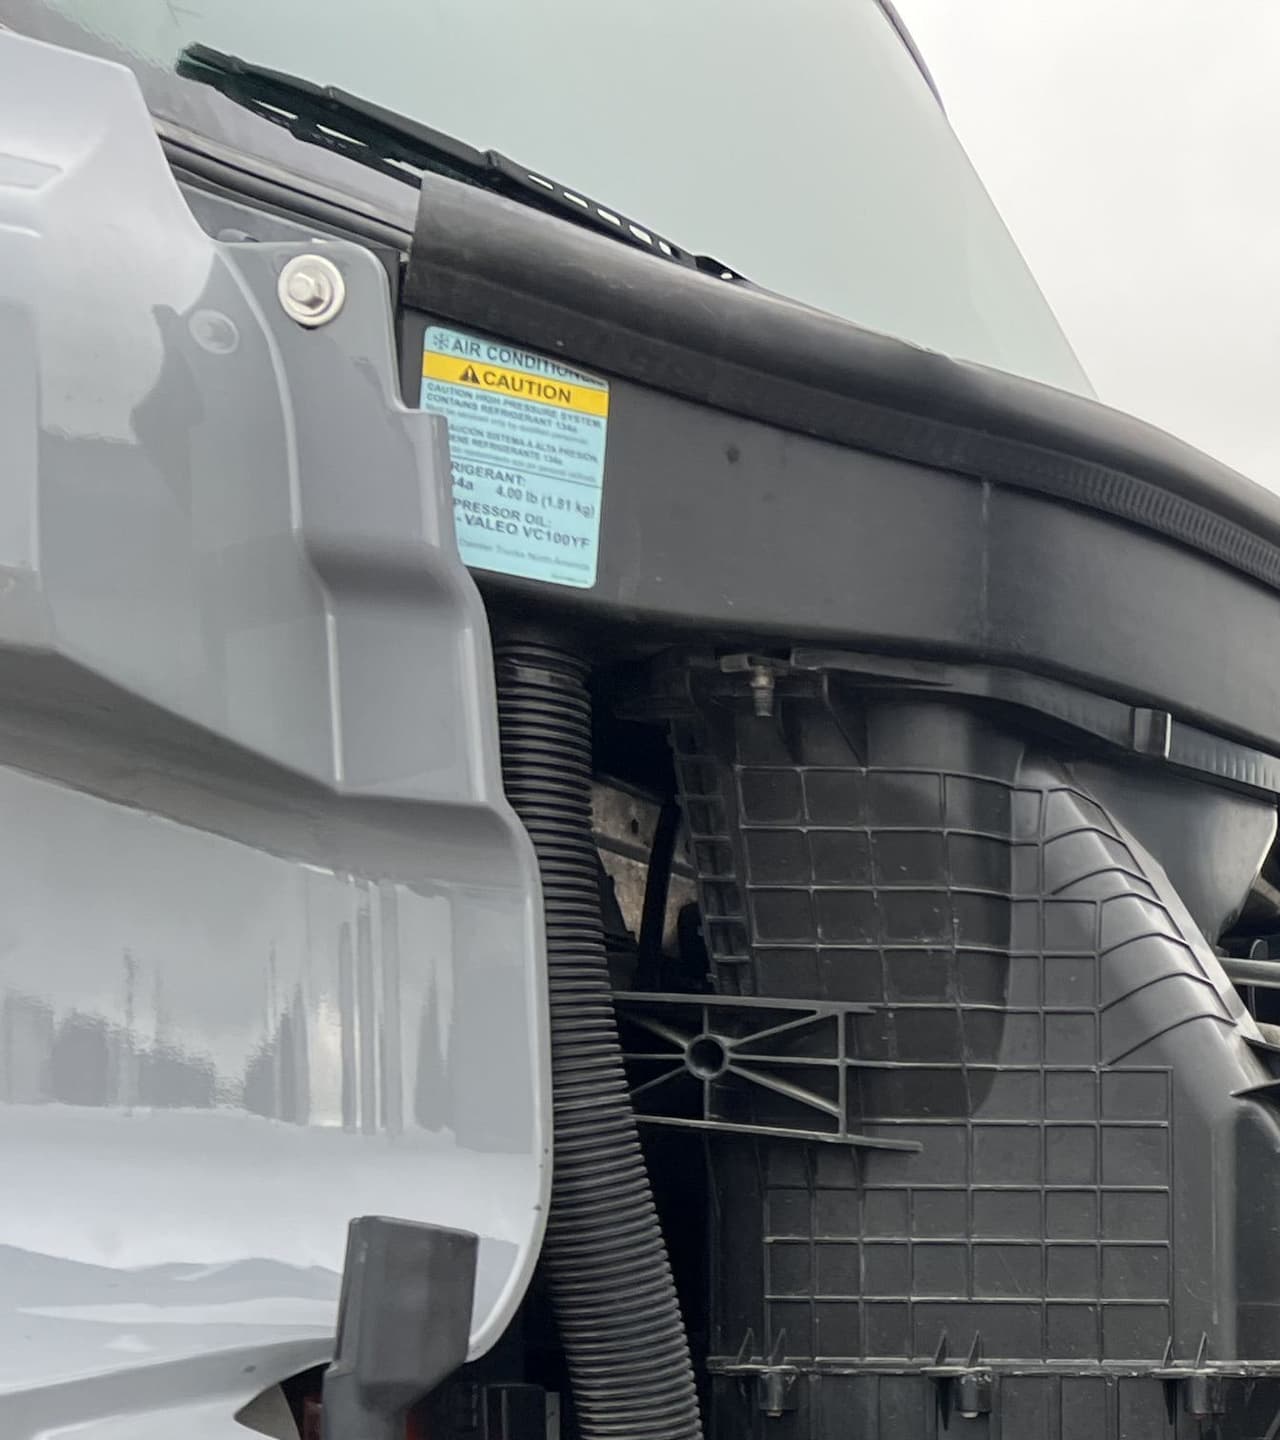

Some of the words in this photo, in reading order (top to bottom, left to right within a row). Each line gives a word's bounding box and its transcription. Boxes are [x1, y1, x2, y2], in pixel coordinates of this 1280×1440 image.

[452, 339, 481, 358] AIR
[487, 346, 605, 387] CONDITION
[427, 383, 473, 399] CAUTION
[503, 398, 557, 419] PRESSURE
[483, 370, 572, 403] CAUTION
[481, 403, 553, 425] REFRIGERANT
[451, 462, 526, 486] RIGERANT:
[453, 498, 521, 522] PRESSOR
[464, 514, 518, 536] VALEO
[522, 526, 591, 549] VC100YF
